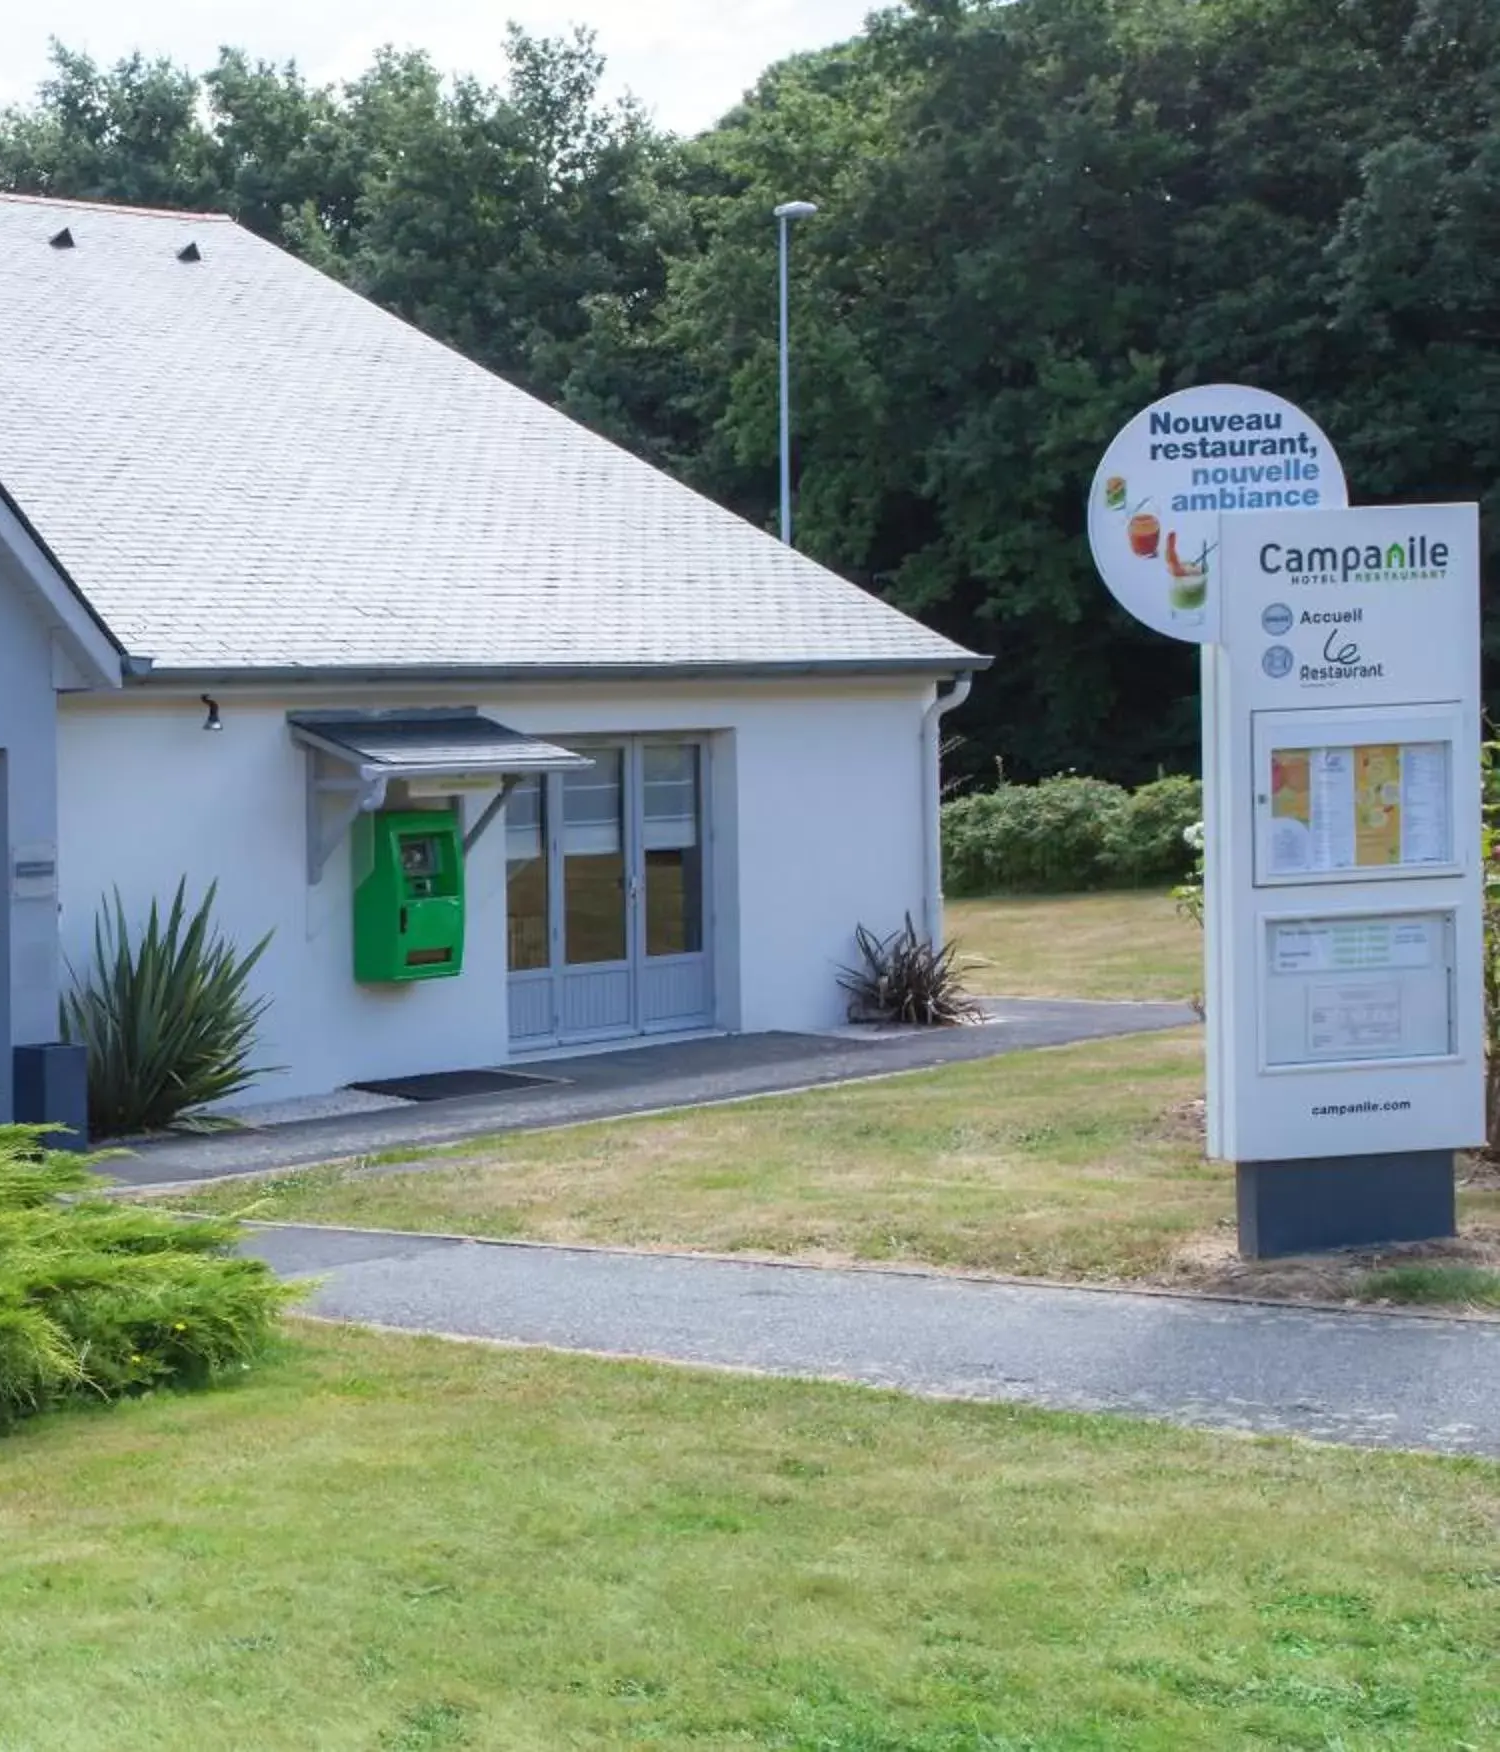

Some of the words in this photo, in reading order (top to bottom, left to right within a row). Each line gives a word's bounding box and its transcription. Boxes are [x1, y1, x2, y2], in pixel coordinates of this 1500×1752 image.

[1150, 411, 1282, 435] Nouveau
[1150, 432, 1317, 460] restaurant,
[1192, 459, 1319, 486] nouvelle
[1171, 487, 1319, 512] ambiance
[1260, 536, 1449, 582] Campanile
[1300, 608, 1363, 624] Accueil
[1323, 628, 1361, 665] Le
[1300, 663, 1384, 681] Restaurant
[1311, 1101, 1411, 1116] campanile.com
